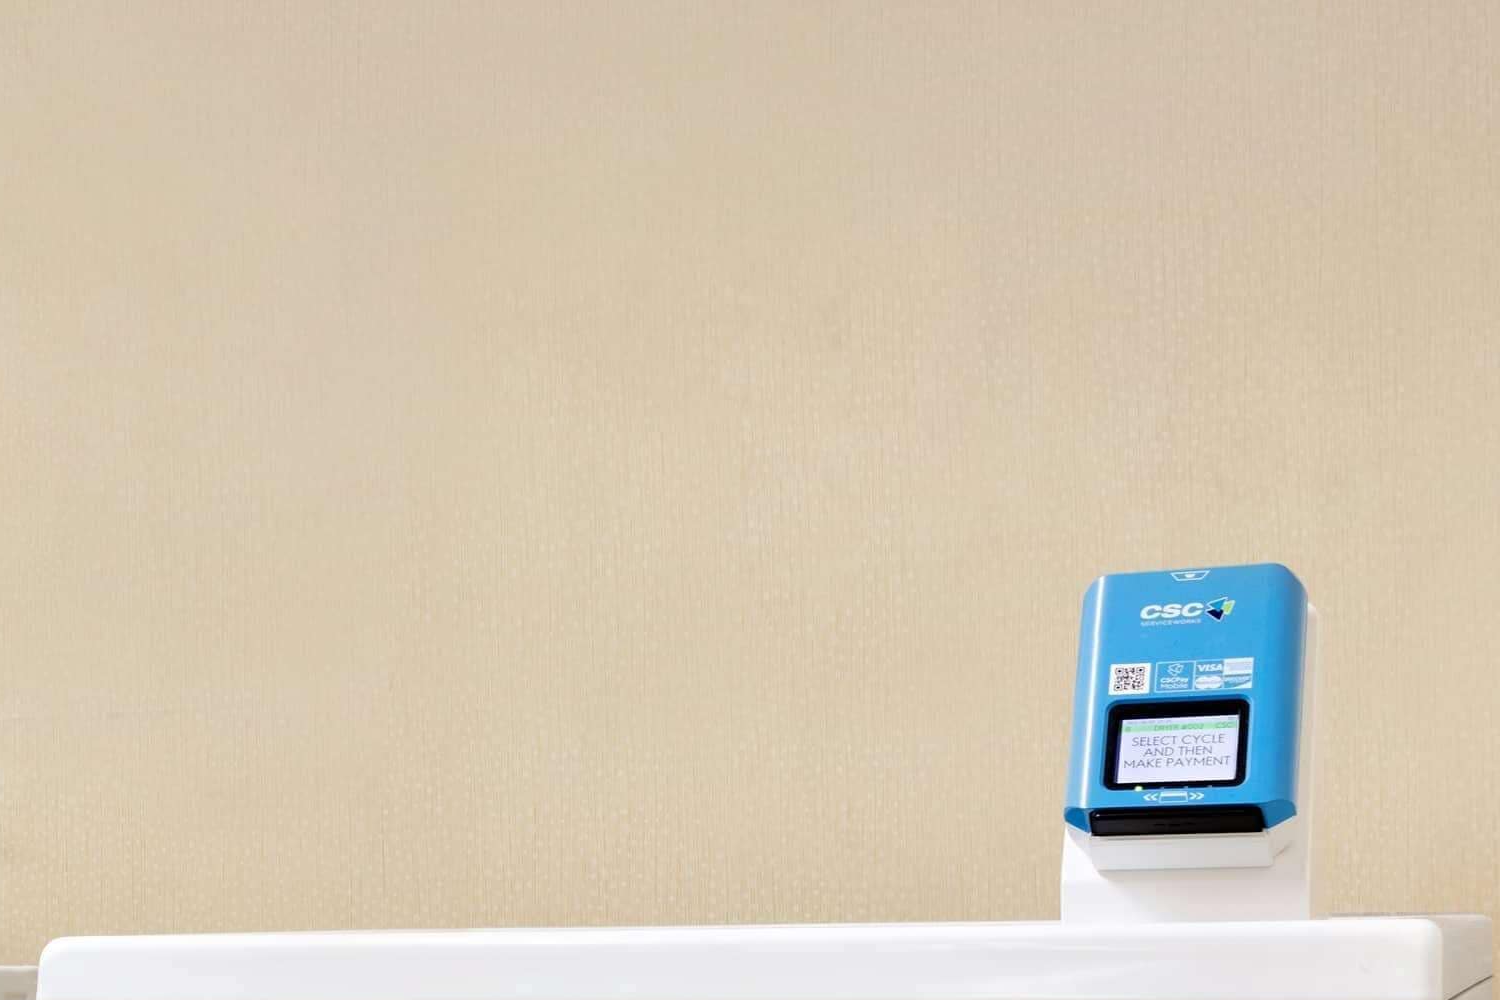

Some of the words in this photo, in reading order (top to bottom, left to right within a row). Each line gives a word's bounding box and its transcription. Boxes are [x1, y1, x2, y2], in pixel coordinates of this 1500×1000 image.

[1140, 602, 1204, 619] CSC
[1197, 663, 1223, 672] VISA
[1132, 736, 1177, 747] SELECT
[1181, 734, 1226, 744] CYCLE
[1143, 747, 1174, 757] AND
[1178, 745, 1213, 755] THEN
[1123, 758, 1162, 768] MAKE
[1166, 756, 1231, 767] PAYMENT
